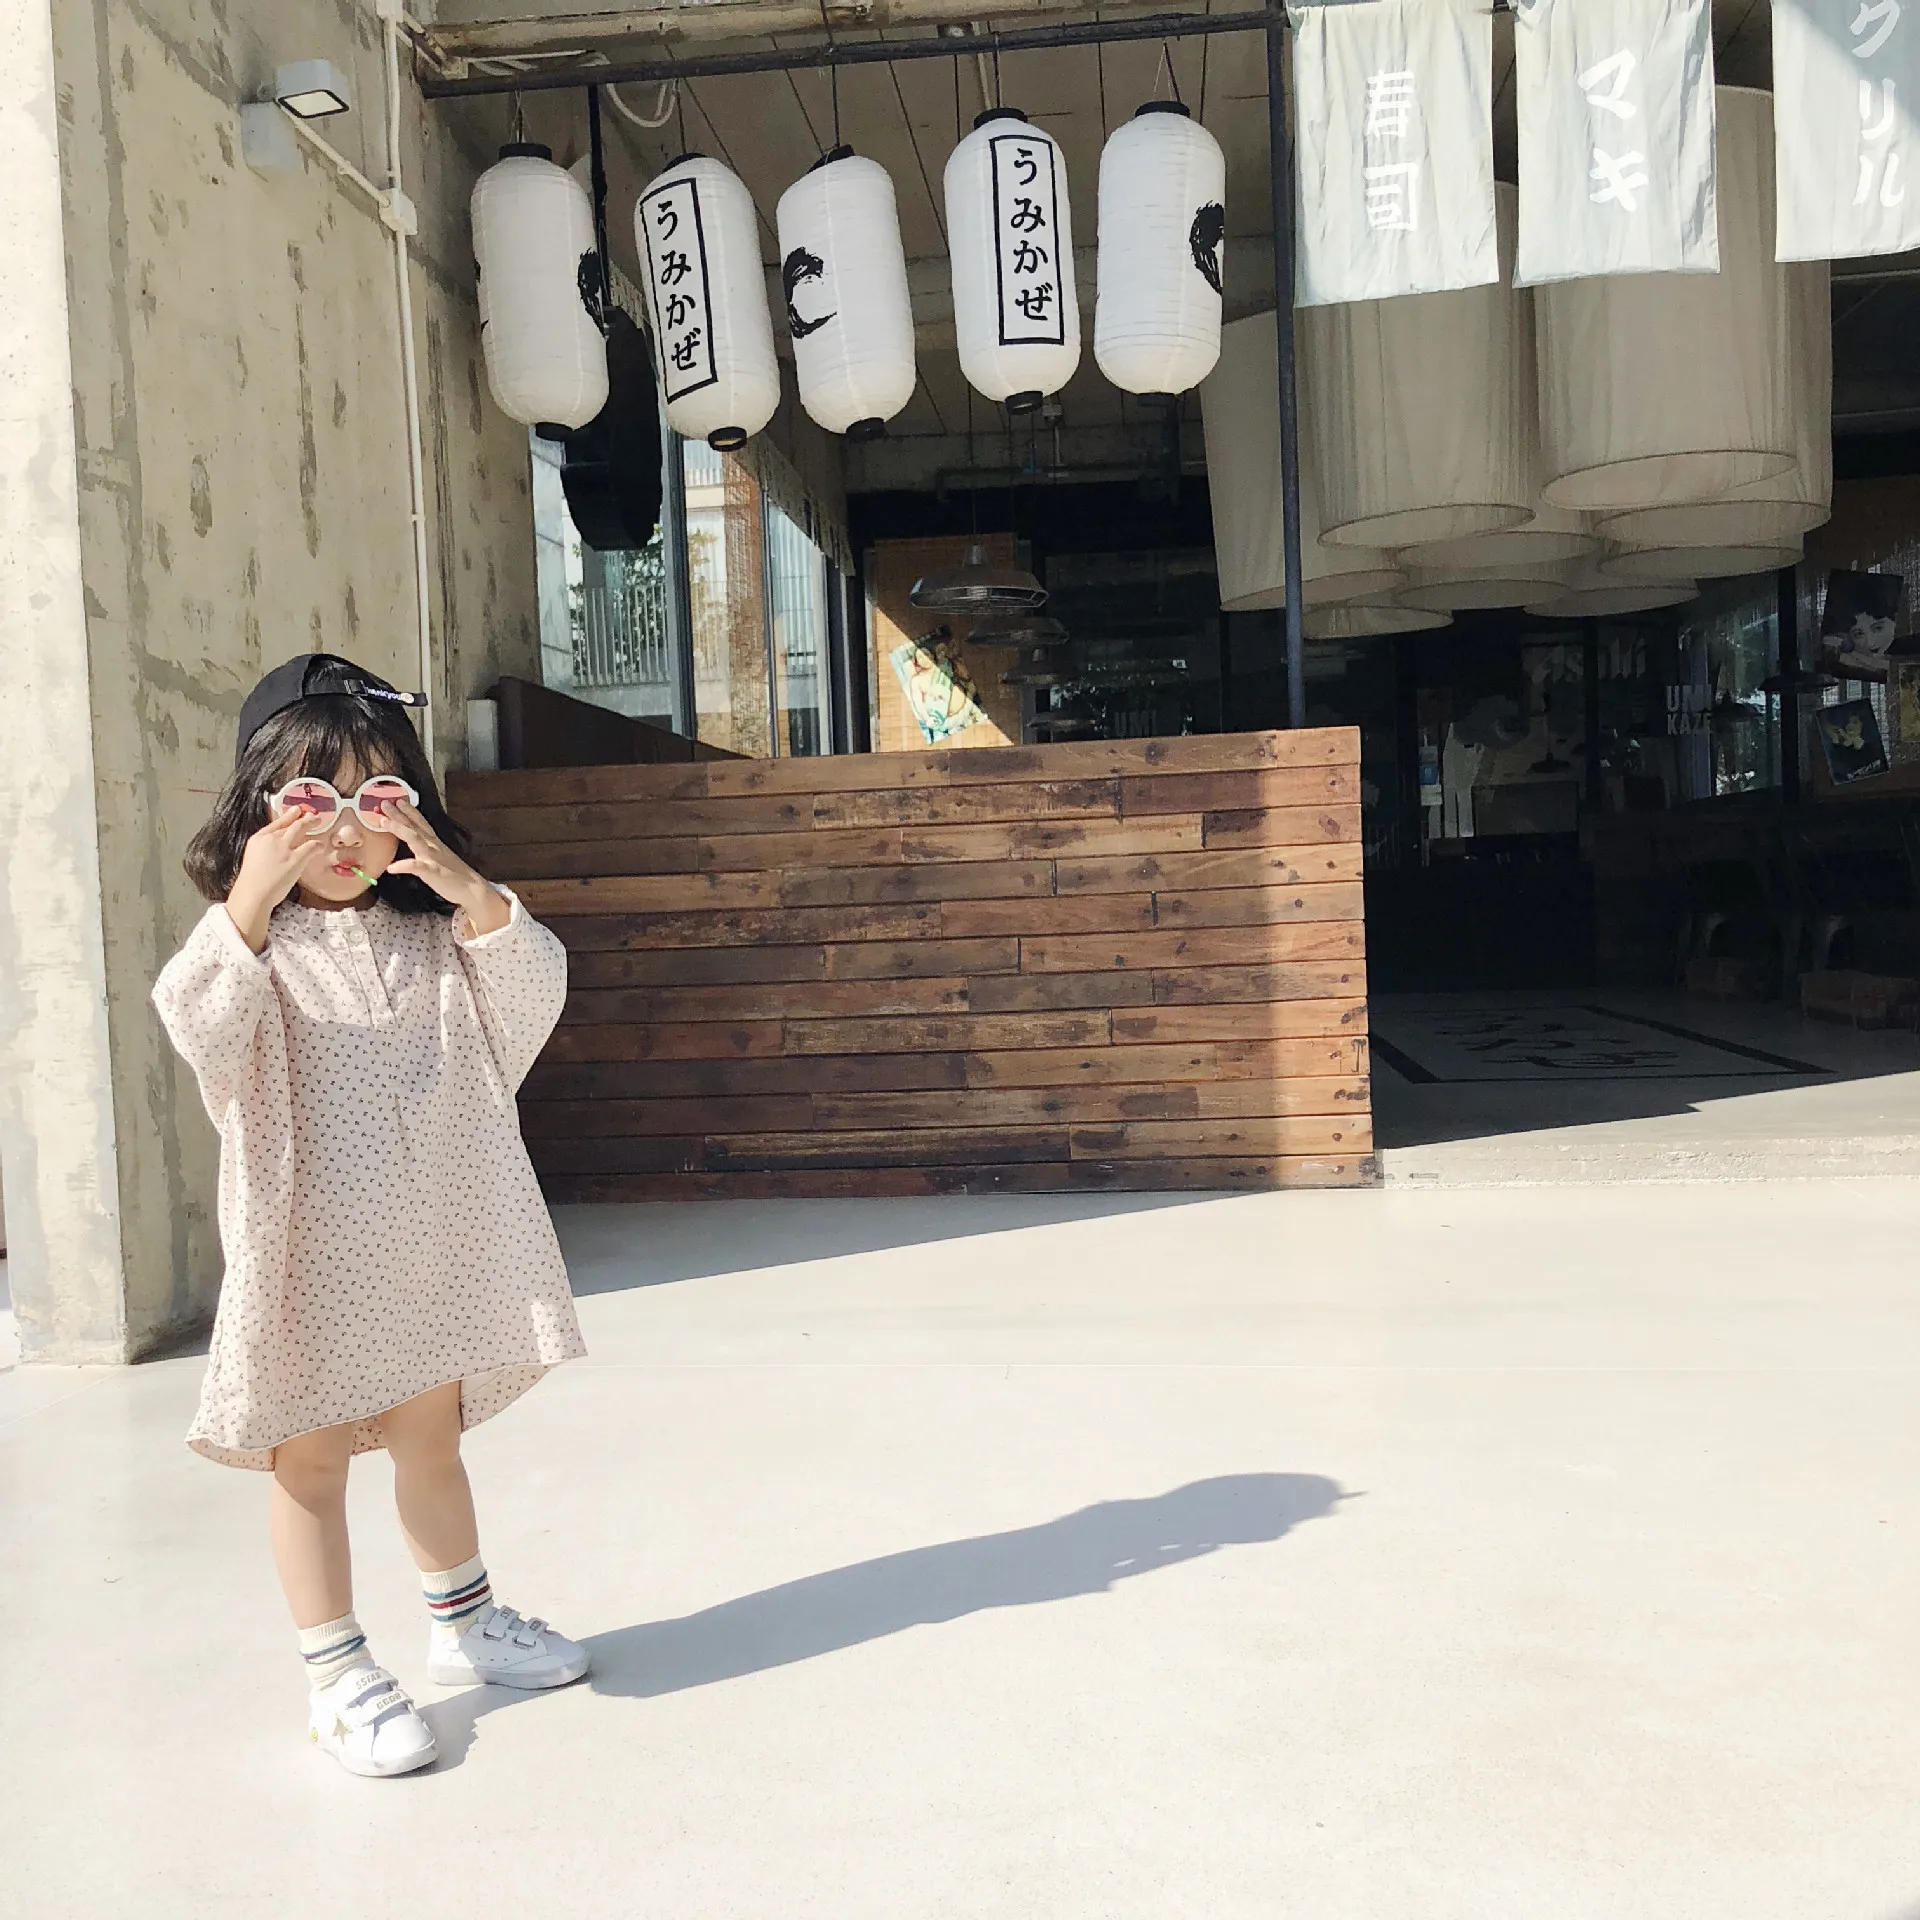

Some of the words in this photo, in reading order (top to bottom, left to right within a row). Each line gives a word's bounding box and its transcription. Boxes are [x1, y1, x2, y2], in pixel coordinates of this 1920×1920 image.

[1577, 49, 1649, 213] マキ
[657, 201, 701, 371] うみかぜ
[1010, 147, 1053, 321] うみかぜ
